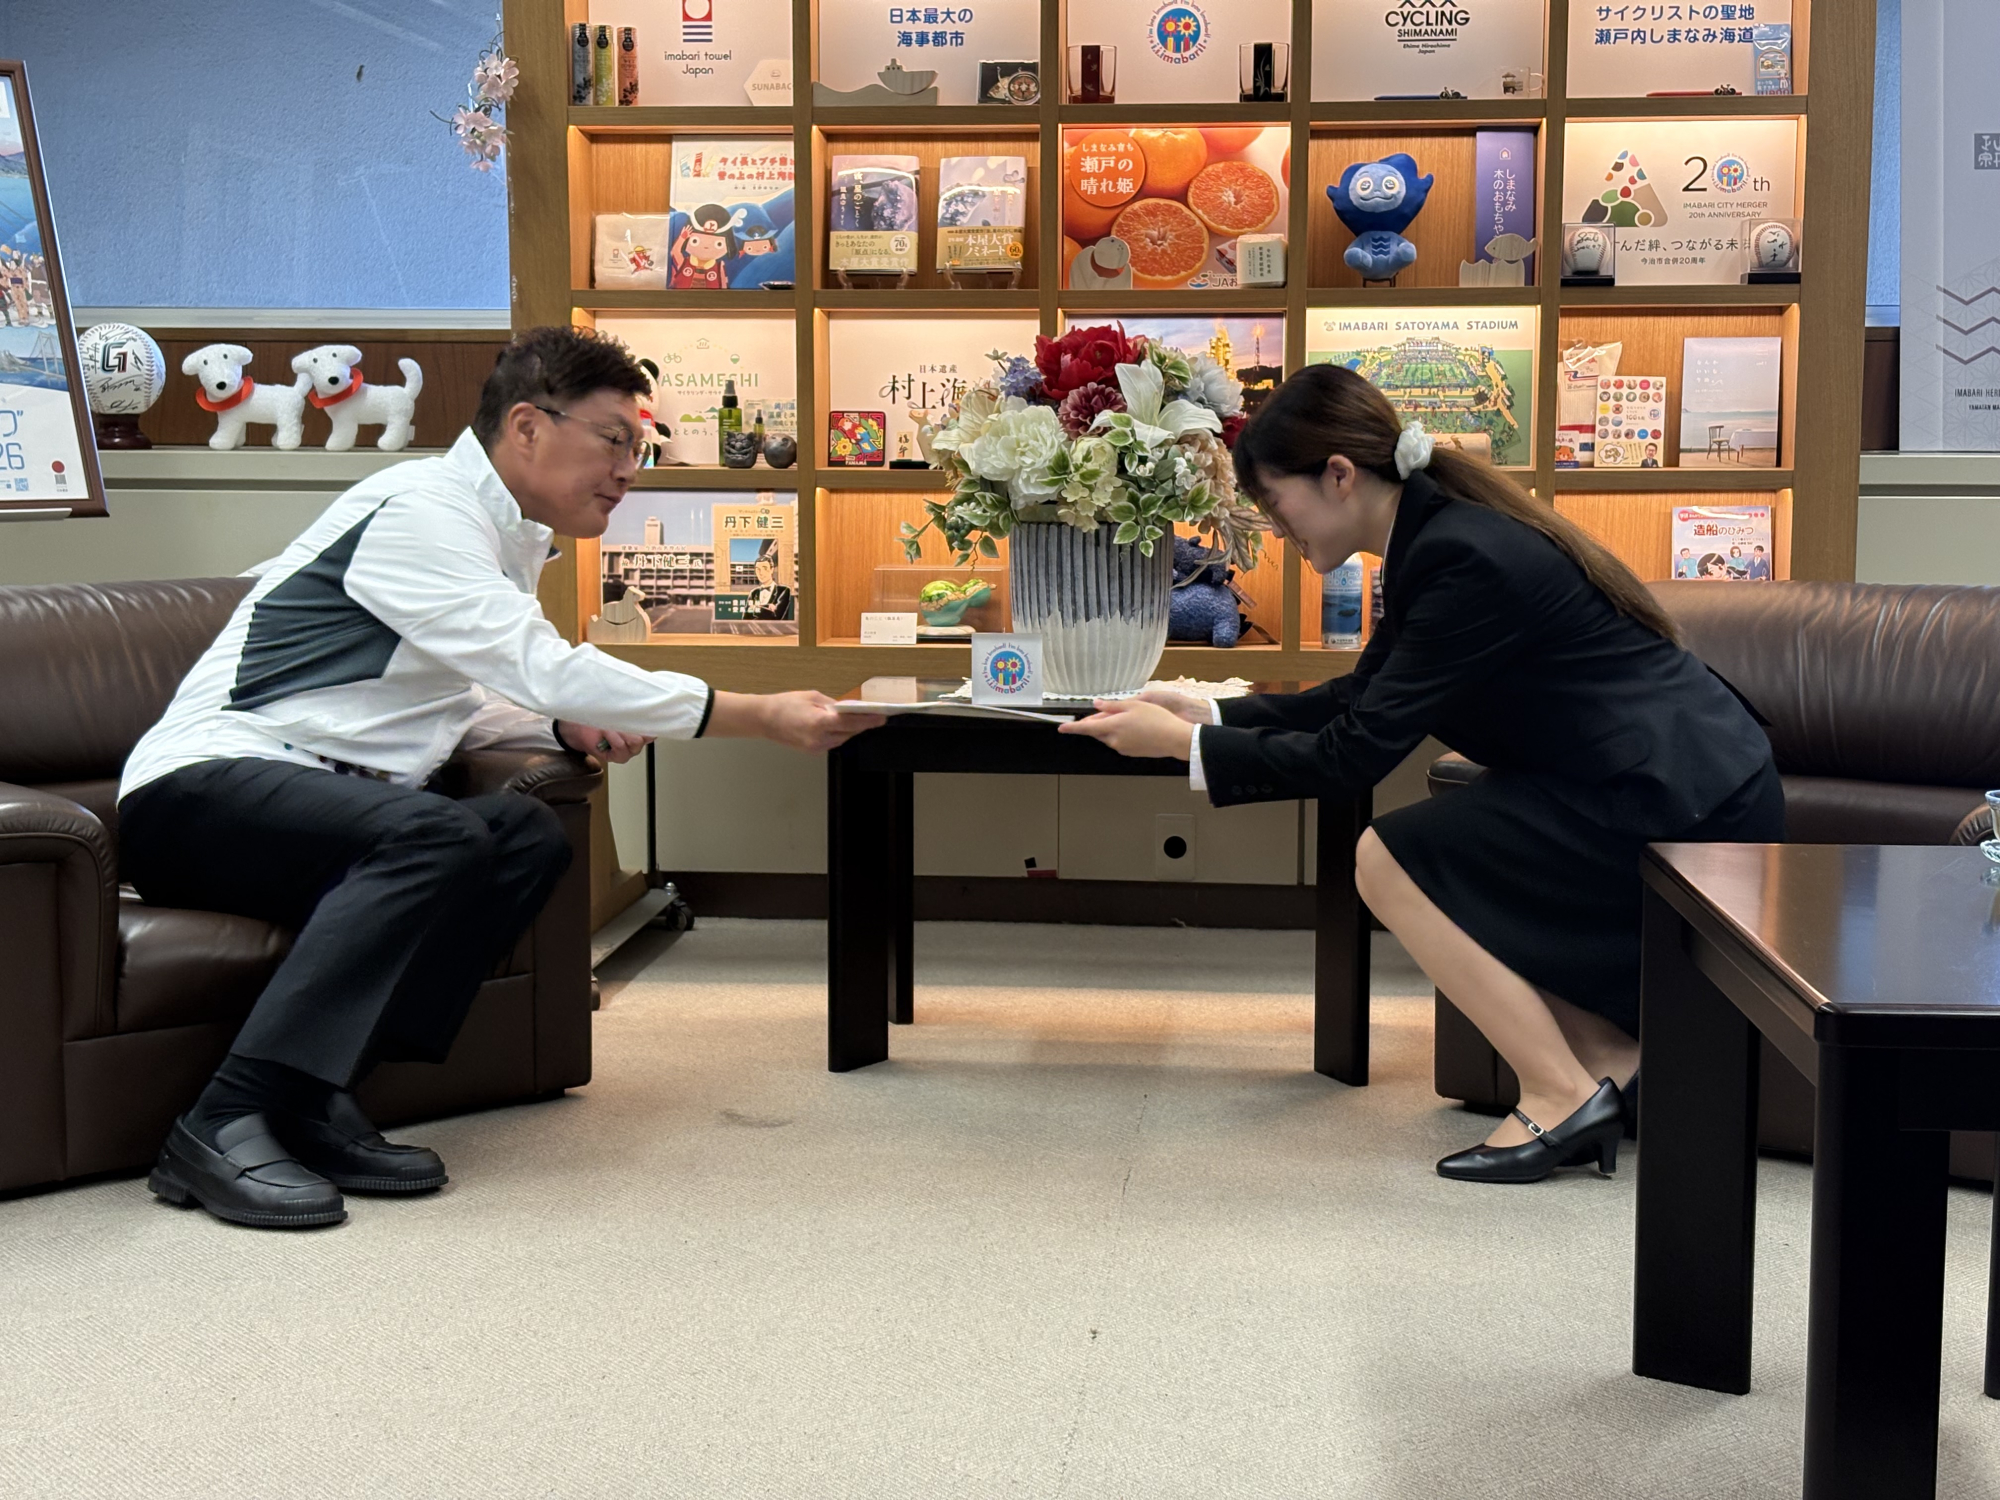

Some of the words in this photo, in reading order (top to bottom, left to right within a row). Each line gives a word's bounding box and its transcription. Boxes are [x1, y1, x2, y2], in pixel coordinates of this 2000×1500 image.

[890, 8, 974, 24] 日本最大の
[1385, 10, 1470, 27] CYCLING
[1596, 5, 1755, 21] サイクリストの聖地
[897, 30, 966, 48] 海事都市
[1397, 28, 1458, 38] SHIMANAMI
[1595, 28, 1754, 45] 瀬戸内しまなみ海道
[664, 51, 701, 61] imabari
[704, 50, 732, 61] towel
[682, 65, 714, 78] Japan
[1082, 142, 1134, 152] しまなみ育ち
[1080, 156, 1133, 173] 瀬戸の
[1080, 178, 1135, 195] 晴れ姫
[1505, 168, 1517, 212] しまなみ
[1716, 201, 1735, 209] CITY
[1707, 211, 1762, 219] ANNIVERSARY
[965, 232, 1014, 246] 本屋大賞
[965, 245, 1006, 257] ノミネート
[1641, 257, 1706, 265] 今治市合併20周年
[1339, 321, 1388, 331] IMABARI
[1395, 321, 1460, 331] SATOYAMA
[1466, 320, 1519, 330] STADIUM
[919, 364, 958, 374] 日本遺産
[1954, 388, 1983, 398] IMABARI
[725, 516, 784, 529] 丹下健三
[1693, 524, 1754, 536] 造船のひみつ
